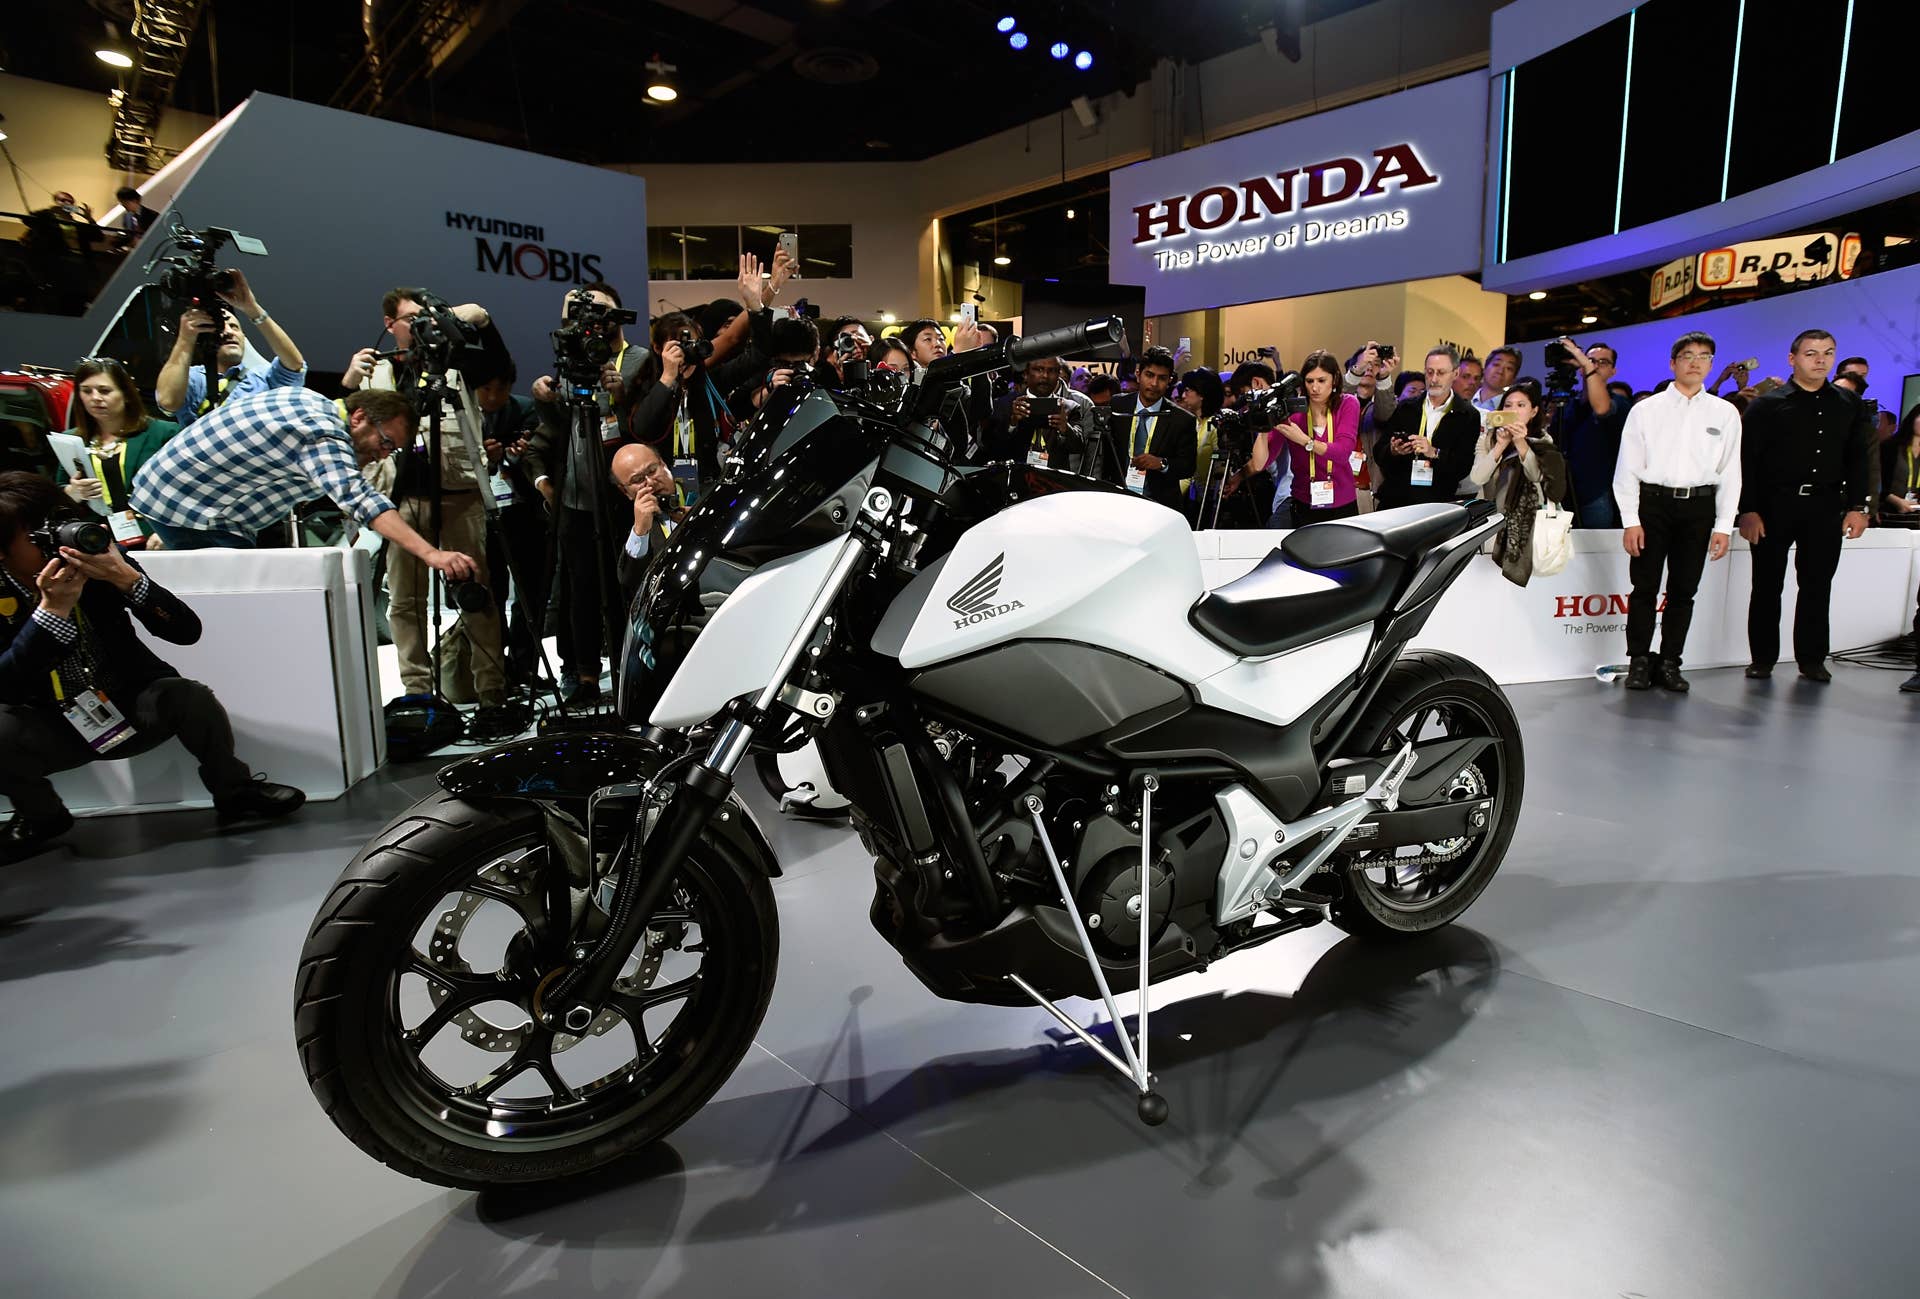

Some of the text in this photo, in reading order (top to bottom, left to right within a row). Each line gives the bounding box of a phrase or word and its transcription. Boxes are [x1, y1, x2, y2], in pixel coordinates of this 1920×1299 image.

[1132, 143, 1439, 245] HONDA
[445, 211, 544, 241] HYUNDAI
[1154, 207, 1406, 271] The Power of Dreams
[475, 237, 604, 285] MOBIS
[953, 599, 1025, 630] HONDA
[1554, 592, 1668, 618] HON
[1563, 623, 1583, 634] The
[1586, 622, 1618, 634] Power
